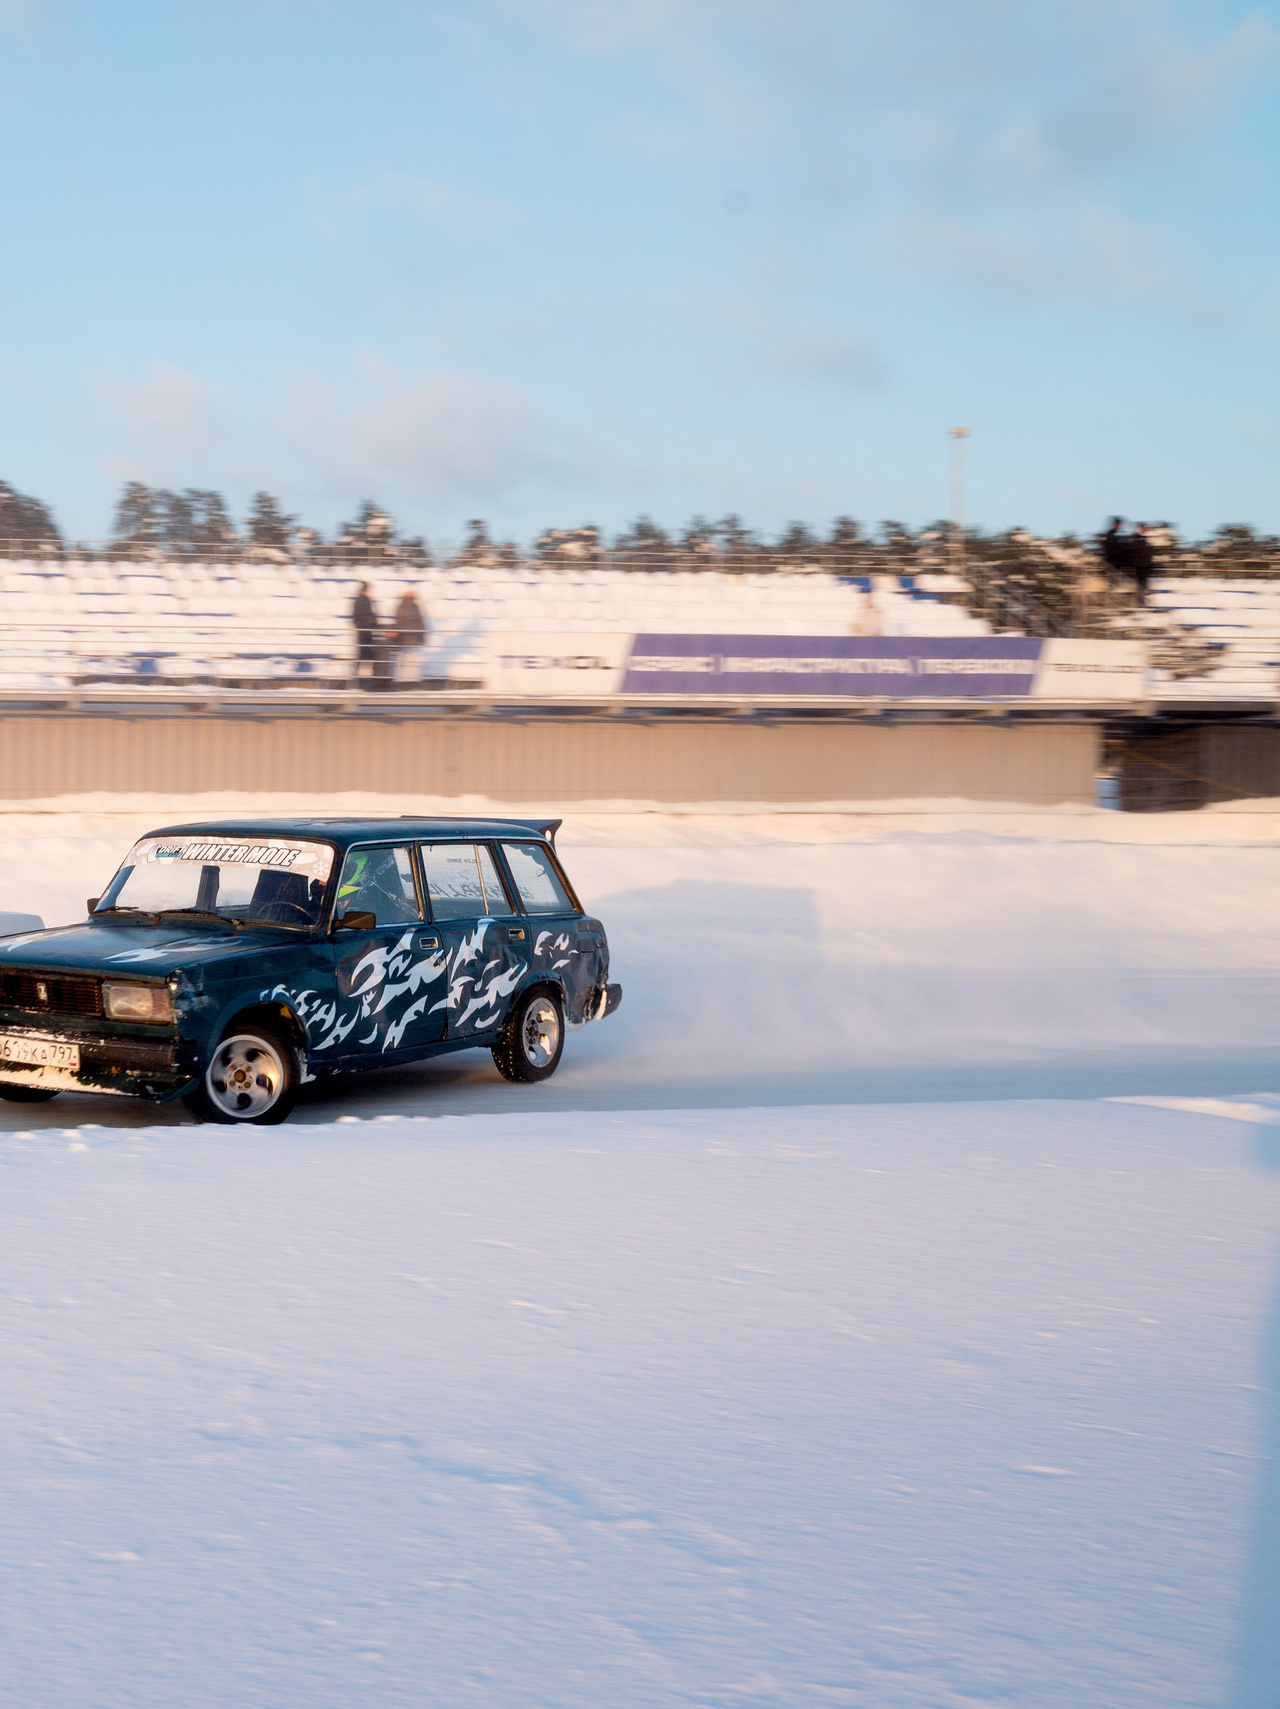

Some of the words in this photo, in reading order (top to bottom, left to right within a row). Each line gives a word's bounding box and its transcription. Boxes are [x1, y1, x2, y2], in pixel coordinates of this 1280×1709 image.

[181, 843, 250, 863] WINTER
[242, 846, 302, 867] MODE
[51, 1045, 73, 1060] 797
